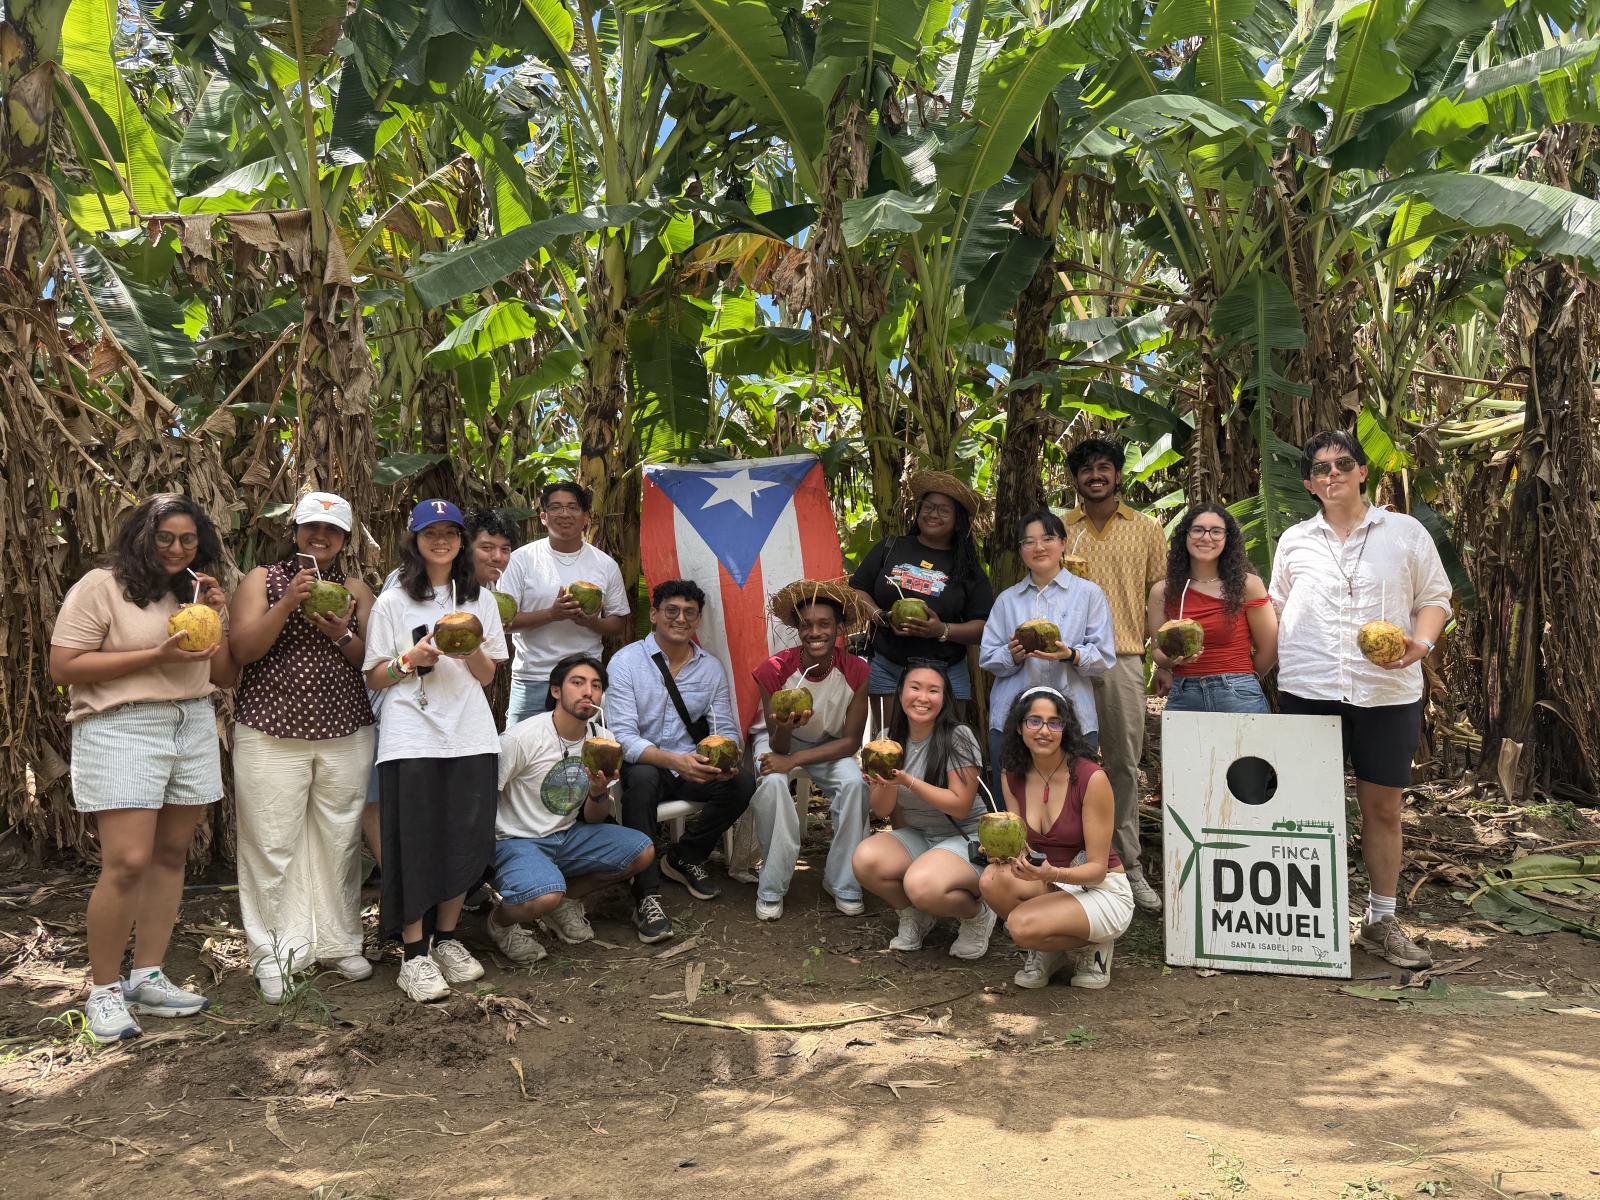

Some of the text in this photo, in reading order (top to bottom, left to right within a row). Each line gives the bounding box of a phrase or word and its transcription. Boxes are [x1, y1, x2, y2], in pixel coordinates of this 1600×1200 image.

[431, 501, 448, 514] T
[1271, 846, 1320, 860] FINCA
[1213, 859, 1321, 908] DON
[1212, 909, 1325, 938] MANUEL
[1231, 941, 1303, 953] SANTA ISABEL, PR
